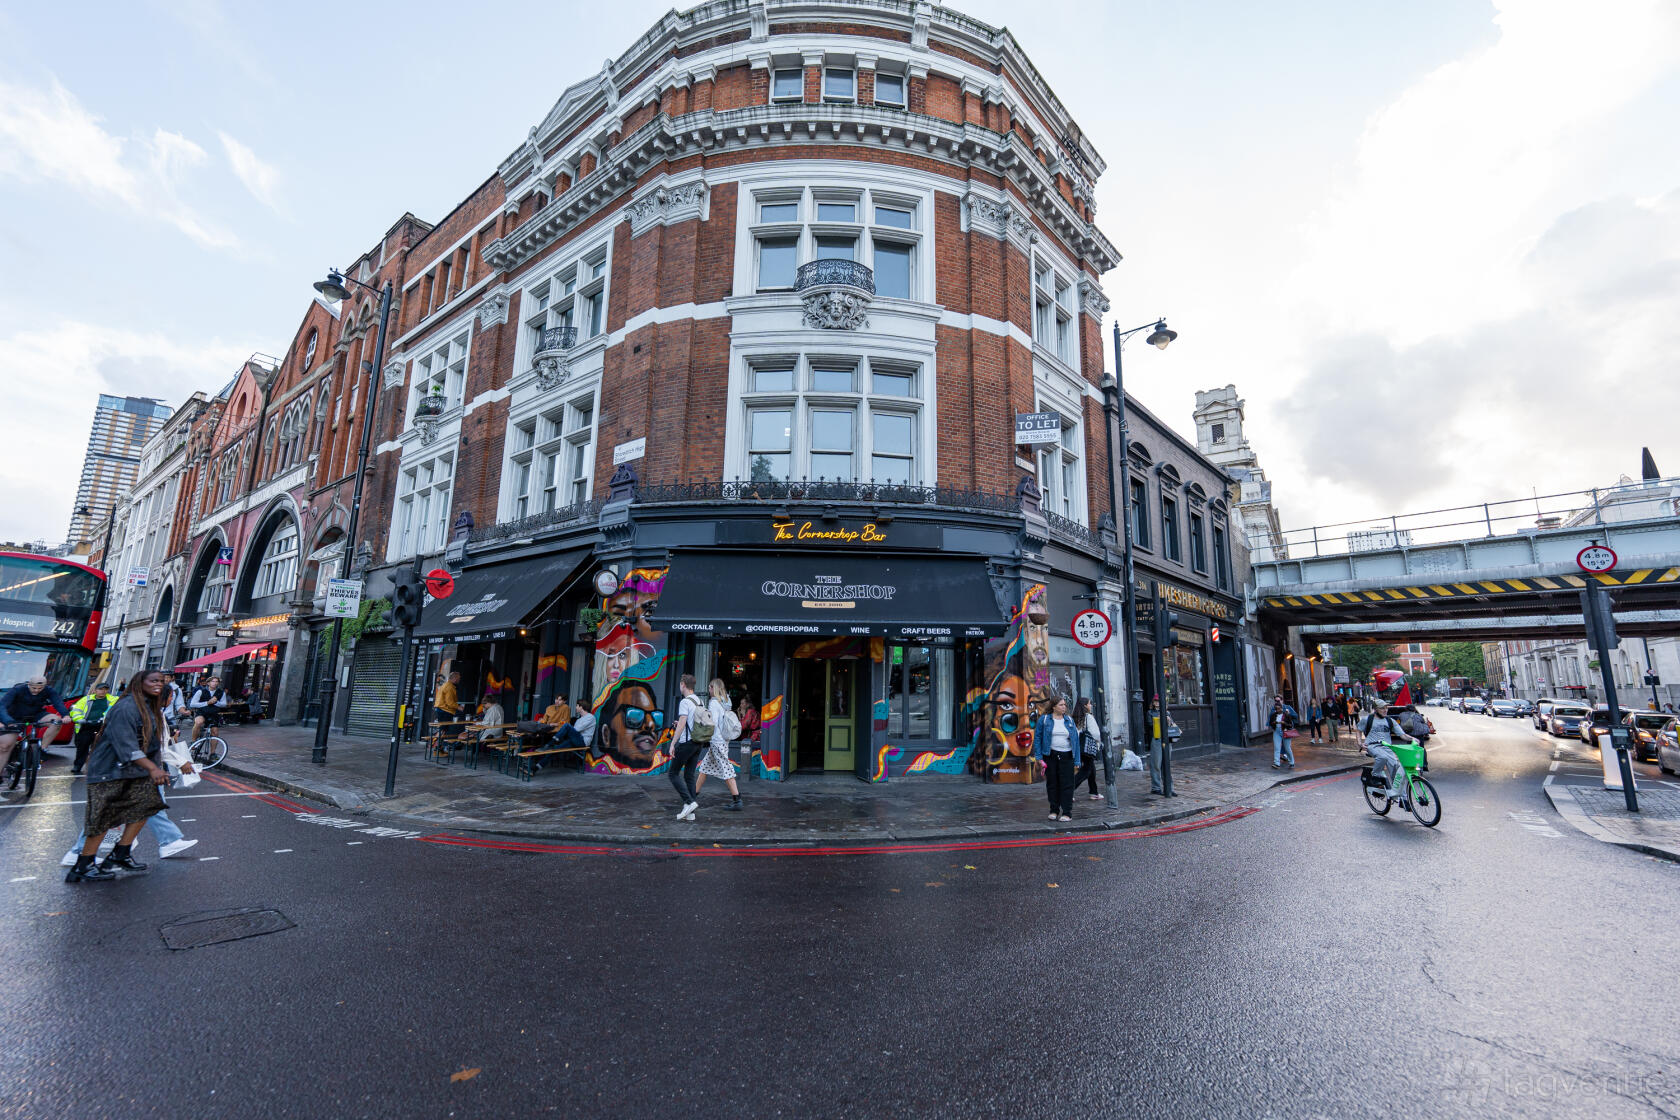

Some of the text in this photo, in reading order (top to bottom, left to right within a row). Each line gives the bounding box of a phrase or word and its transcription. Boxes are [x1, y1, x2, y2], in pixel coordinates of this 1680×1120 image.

[1026, 413, 1050, 421] OFFICE
[1018, 419, 1058, 430] TO LET
[772, 521, 887, 543] The Cornershop Bar
[815, 575, 842, 584] THE
[761, 580, 897, 600] CORNERSHOP
[3, 617, 34, 628] Hospital
[51, 620, 75, 634] 242
[671, 623, 714, 631] COCKTAILS
[745, 624, 820, 633] @CORNERSHOPBAR
[850, 626, 871, 634] WINE
[926, 627, 951, 635] BEERS
